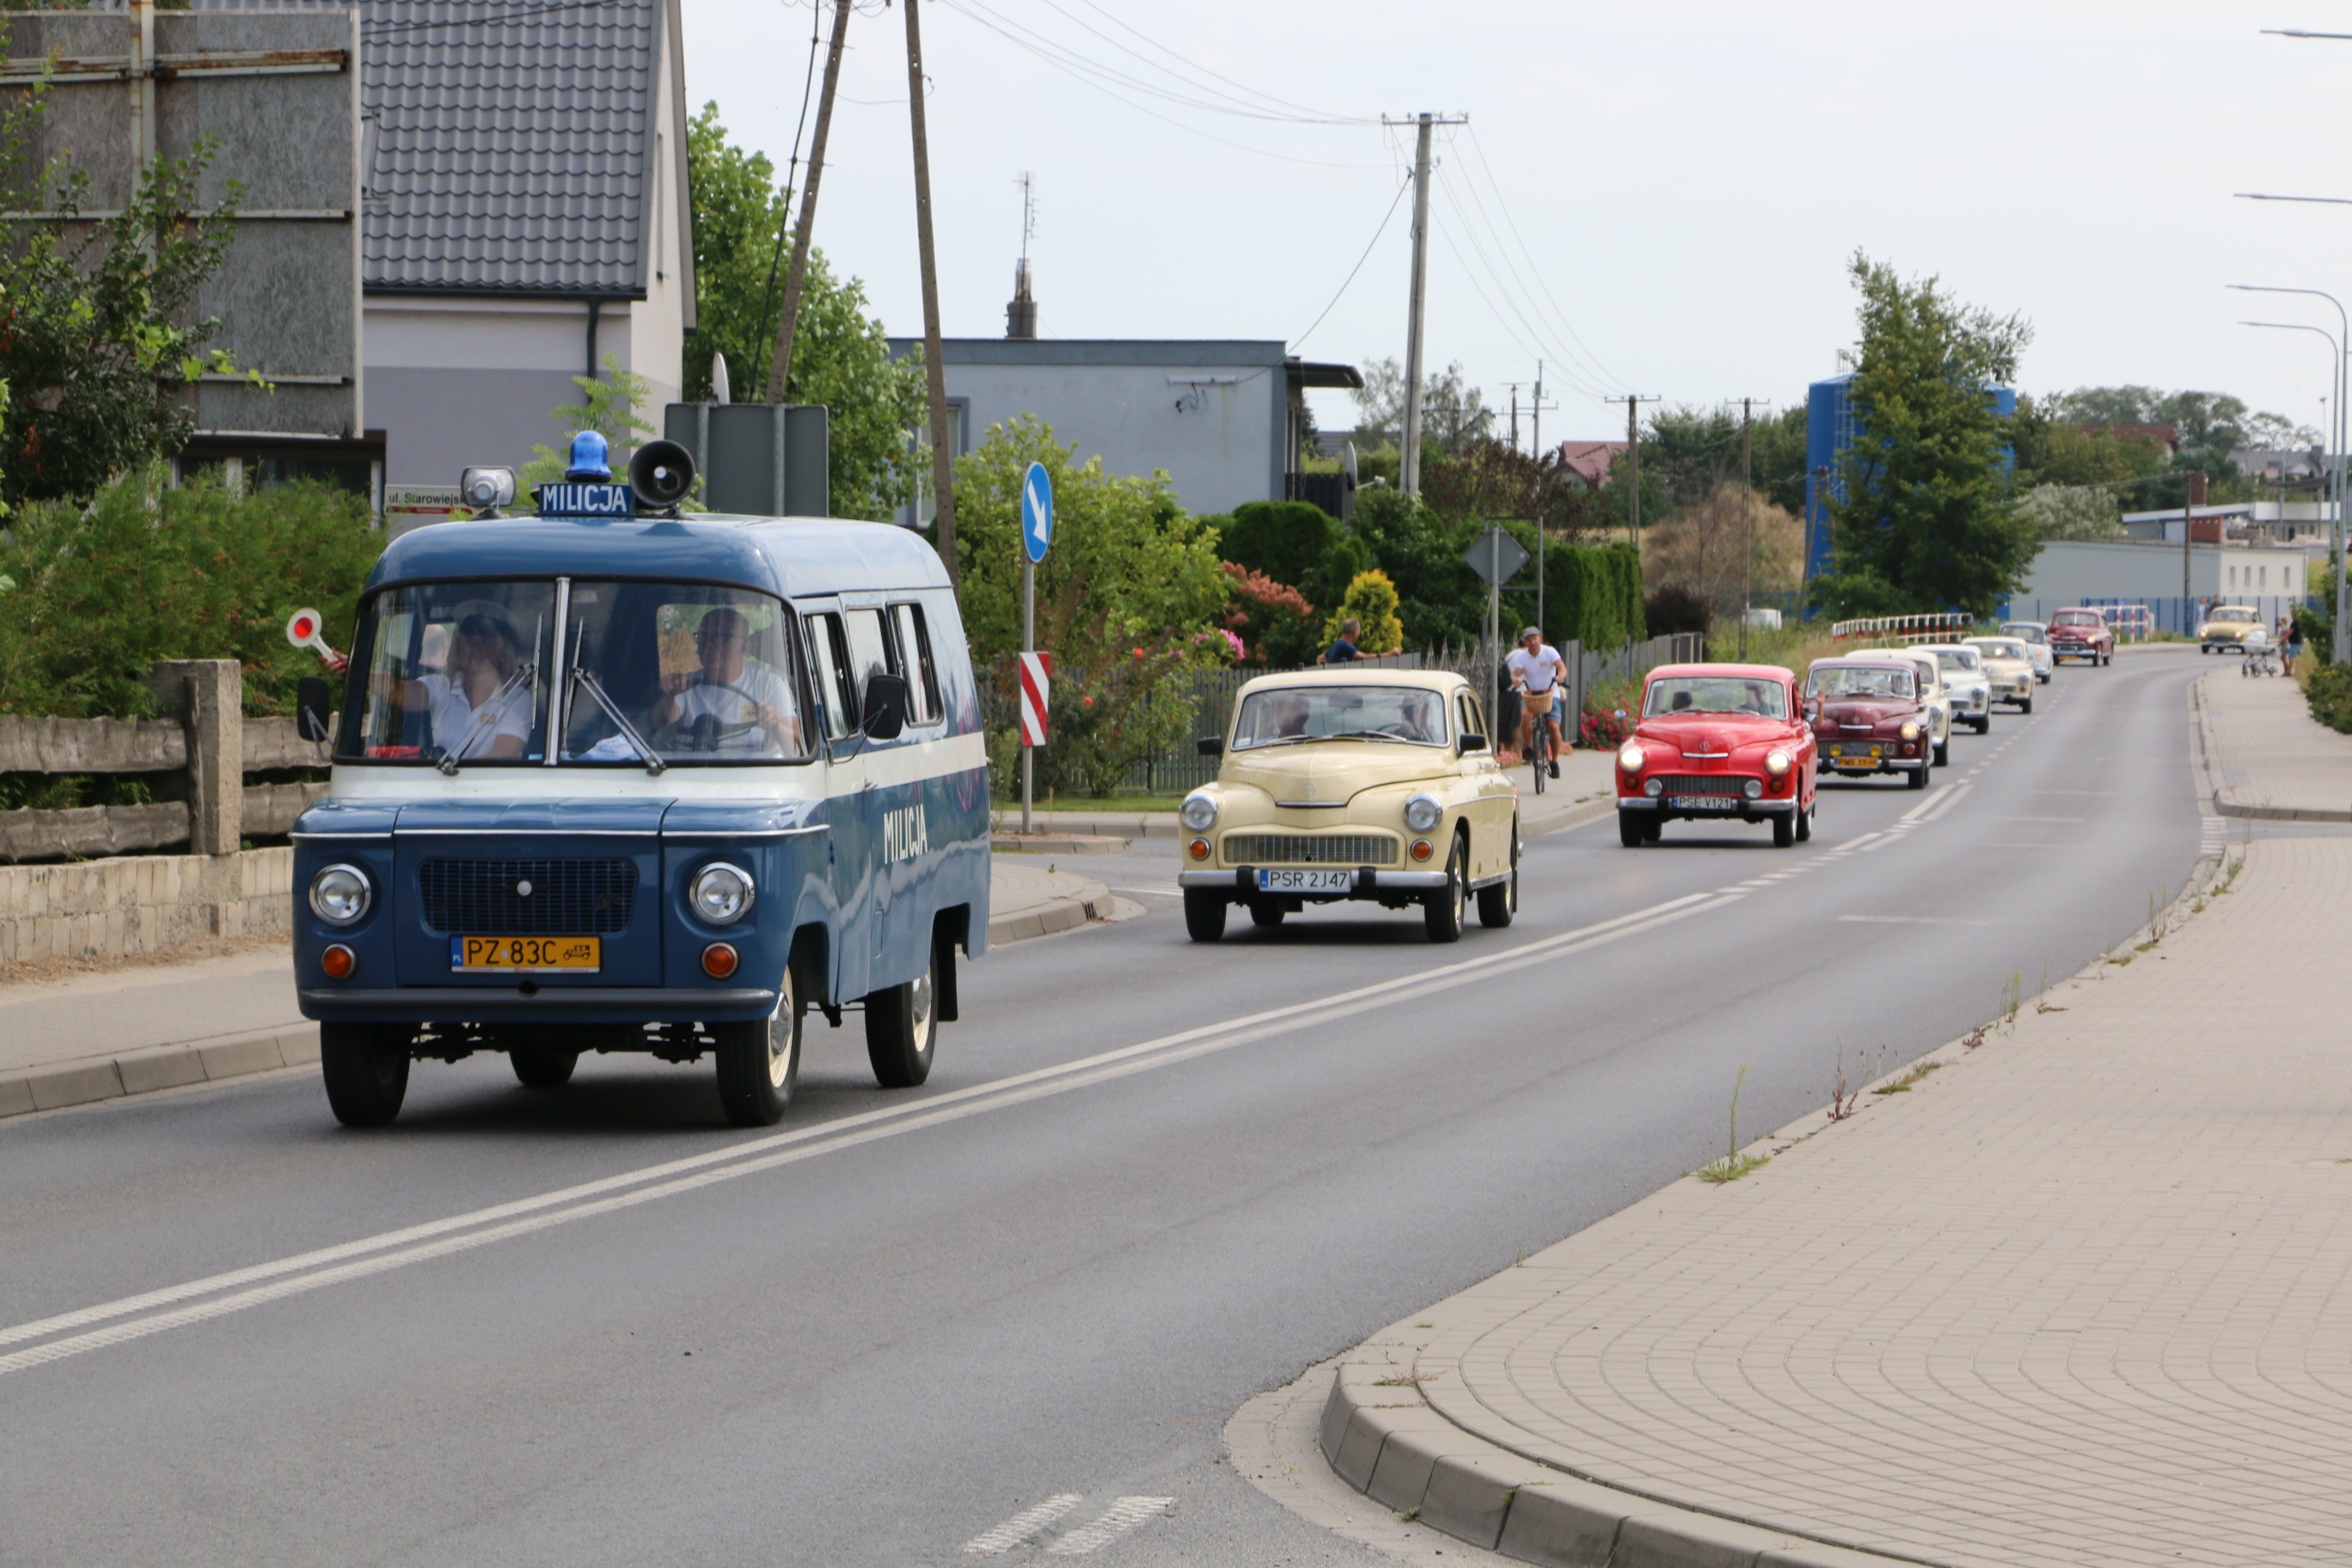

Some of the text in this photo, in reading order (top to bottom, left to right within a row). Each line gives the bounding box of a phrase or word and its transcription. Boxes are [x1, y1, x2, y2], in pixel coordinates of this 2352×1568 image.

[389, 493, 466, 505] ul. Starowiejsk
[542, 484, 628, 513] MILICJA
[1679, 796, 1729, 809] PSE V121
[883, 803, 928, 865] MILICJA
[1270, 872, 1304, 887] PSR
[1309, 872, 1348, 888] 2J47
[452, 939, 557, 965] PL PZ 83C
